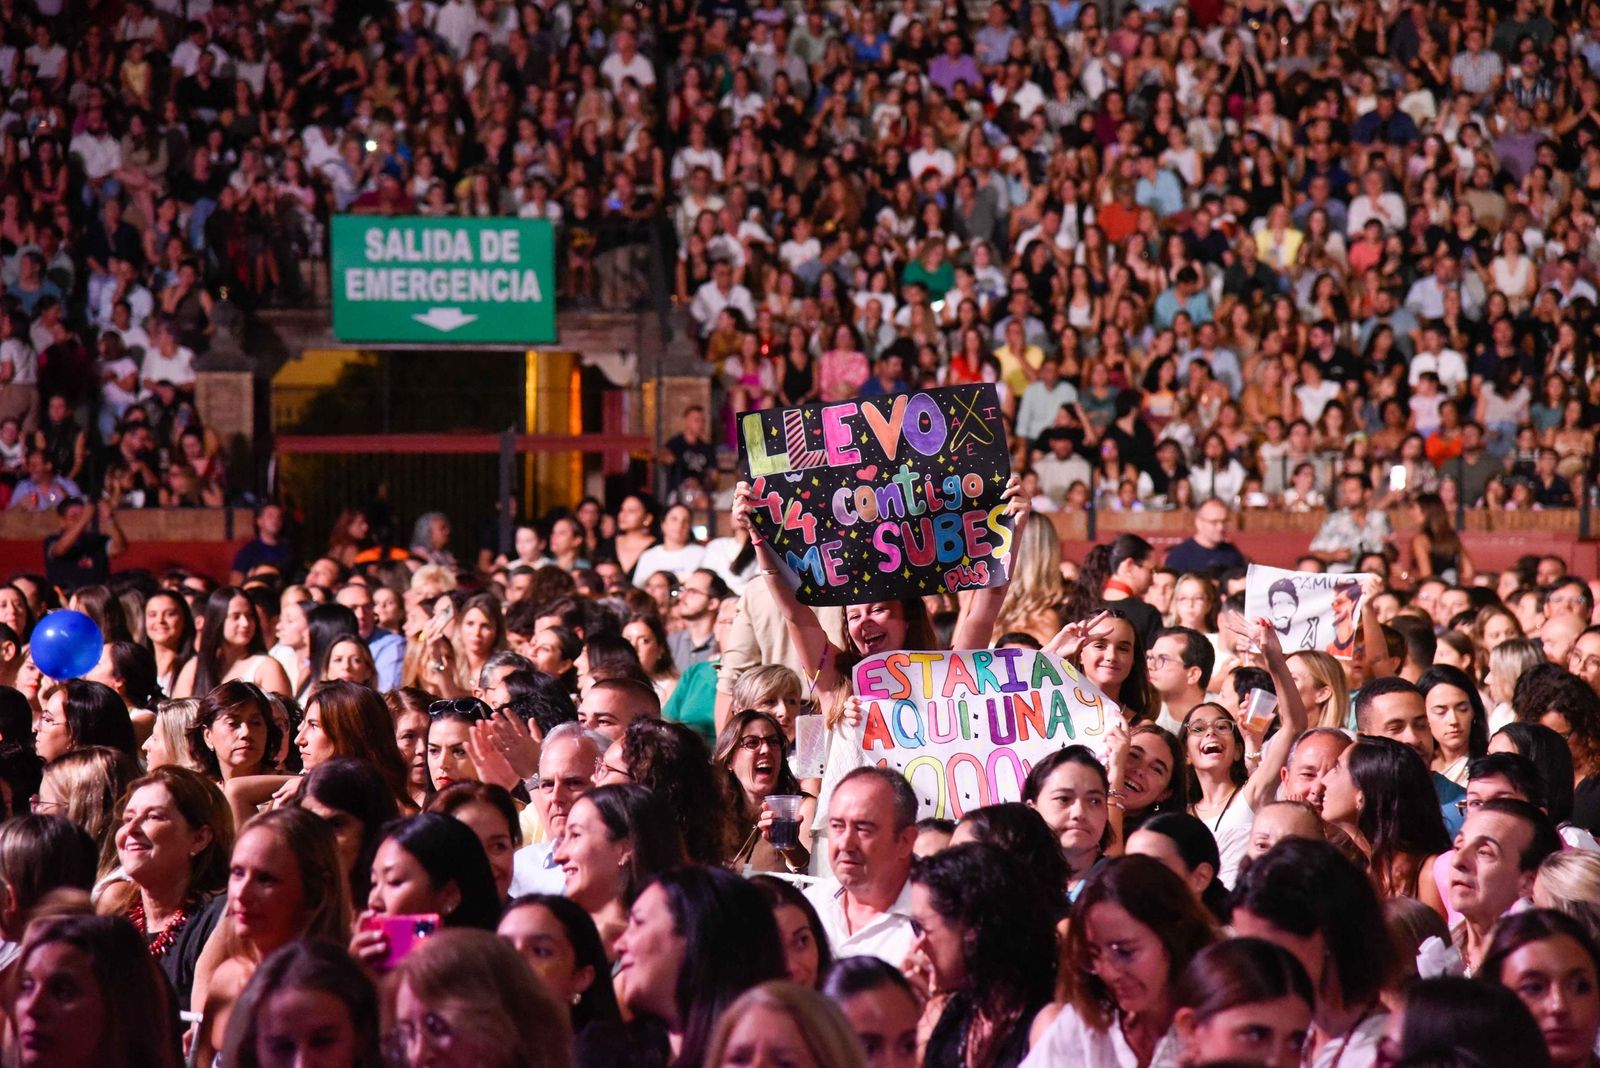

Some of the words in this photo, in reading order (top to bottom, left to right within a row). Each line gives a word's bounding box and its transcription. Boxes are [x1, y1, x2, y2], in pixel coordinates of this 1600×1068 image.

[365, 227, 473, 263] SALIDA
[480, 229, 521, 263] DE
[345, 268, 543, 303] EMERGENCIA
[742, 392, 948, 478] LLEVO
[832, 464, 984, 526] contigo
[785, 540, 850, 587] ME
[986, 689, 1076, 746] UNA
